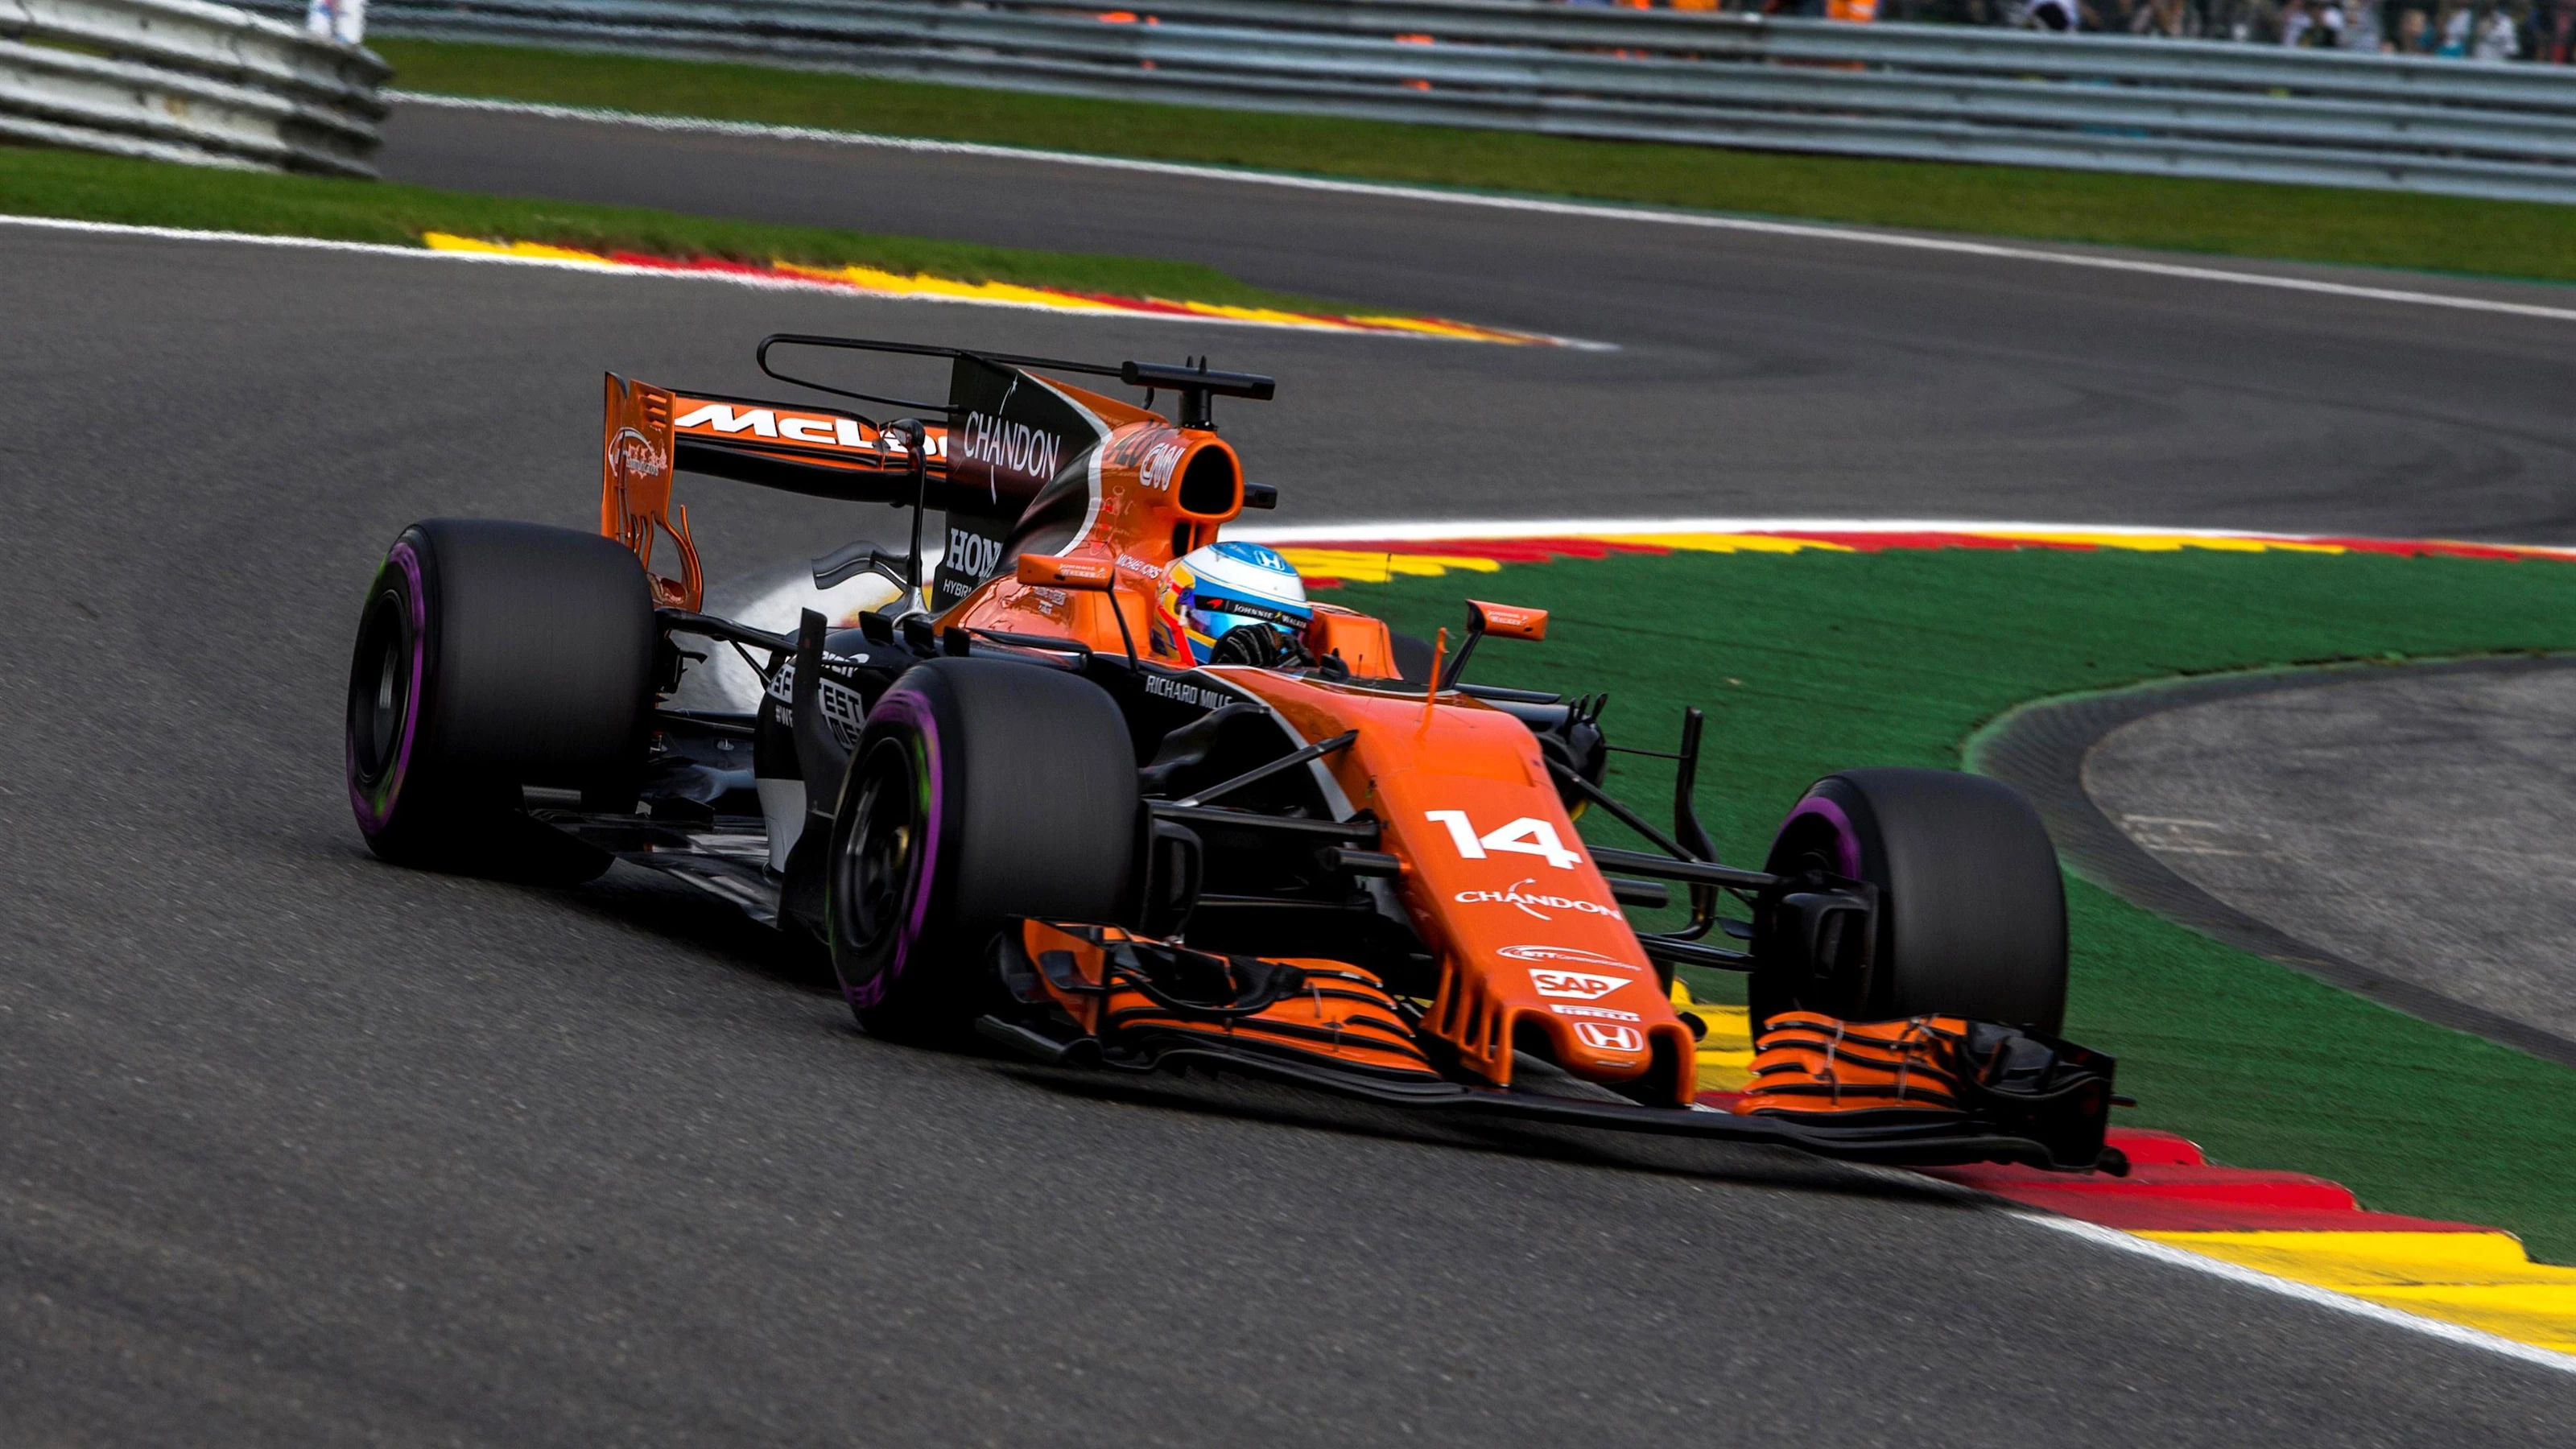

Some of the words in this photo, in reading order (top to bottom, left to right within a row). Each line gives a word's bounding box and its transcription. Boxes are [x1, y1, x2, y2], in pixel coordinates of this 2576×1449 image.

[964, 411, 1060, 481] CHANDON
[1140, 443, 1186, 492] CNN
[1146, 675, 1198, 704] RICHARD
[1424, 810, 1583, 870] 14
[1455, 890, 1624, 920] CHANDON
[1534, 974, 1608, 994] SAP
